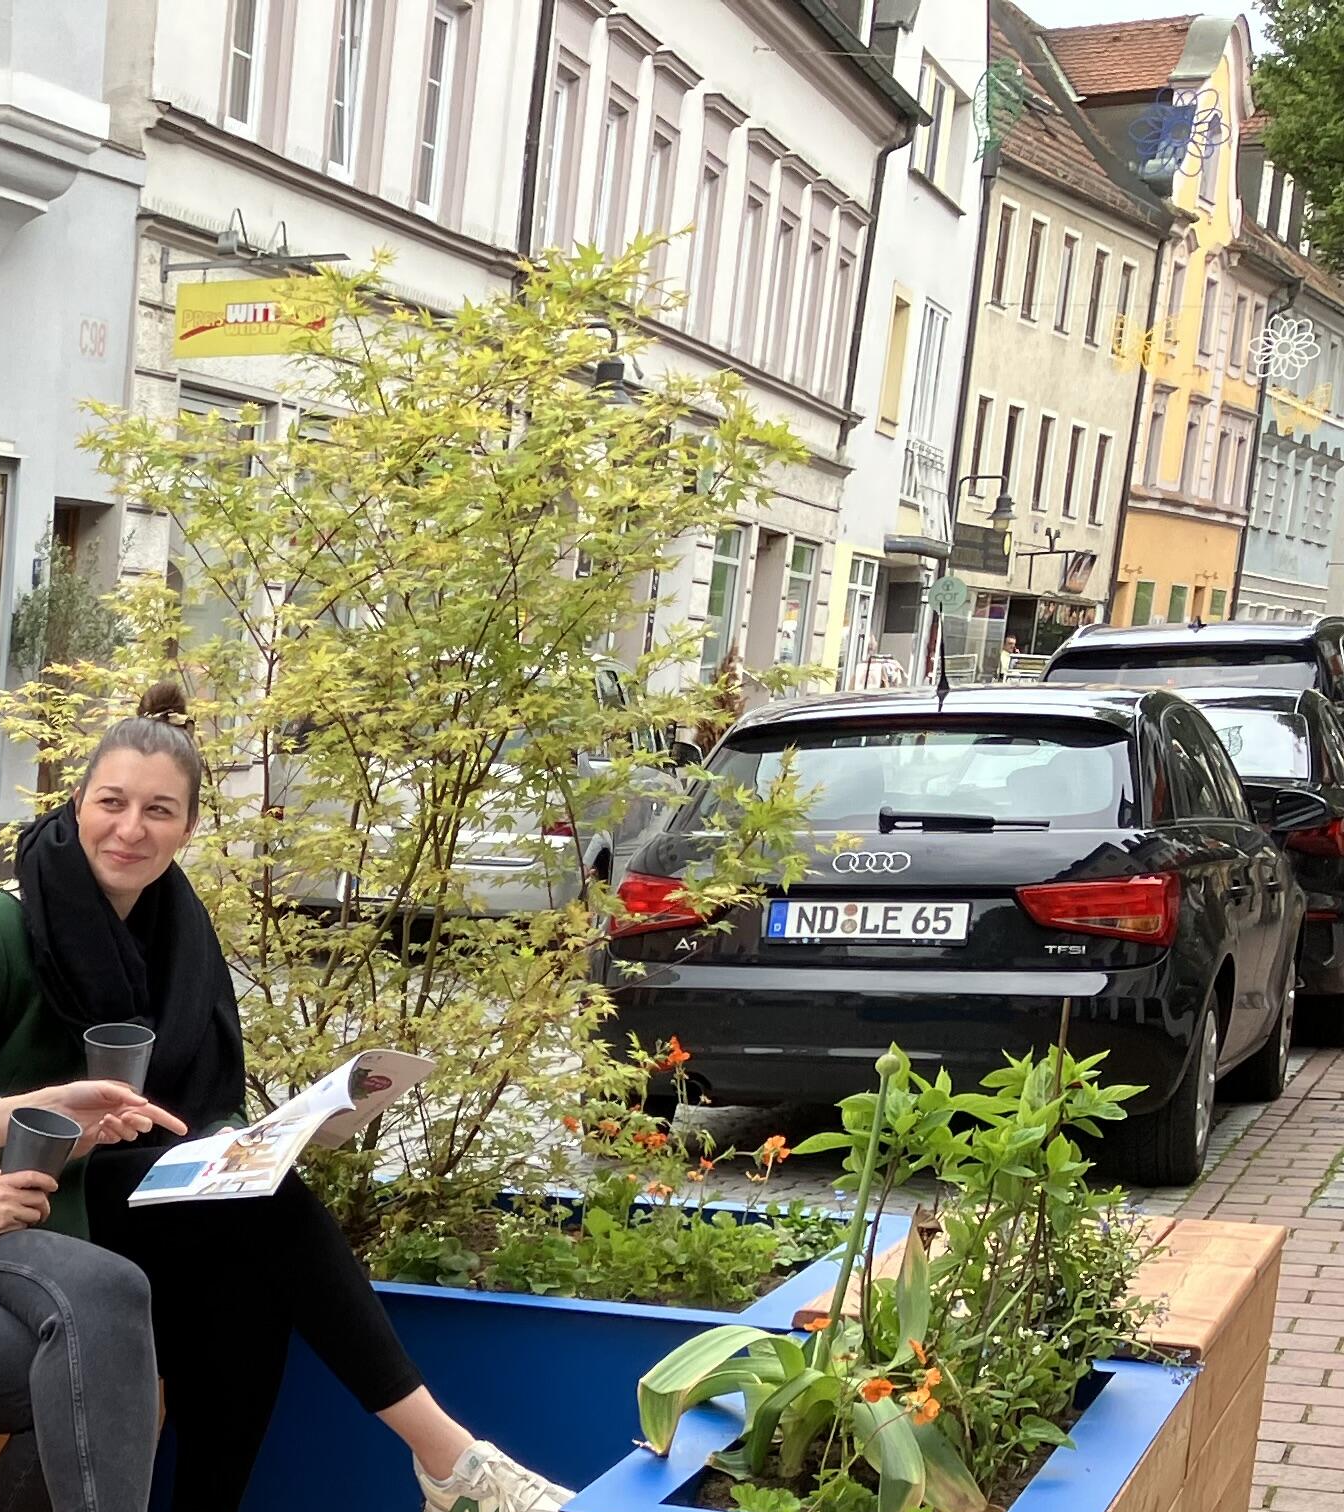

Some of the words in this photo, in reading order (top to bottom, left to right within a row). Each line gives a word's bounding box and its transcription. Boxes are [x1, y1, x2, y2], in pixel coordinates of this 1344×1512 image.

[79, 319, 106, 357] C98
[796, 906, 839, 934] ND
[859, 906, 903, 934] LE
[911, 906, 954, 935] 65
[674, 937, 698, 951] A1
[1044, 945, 1086, 954] TFSI
